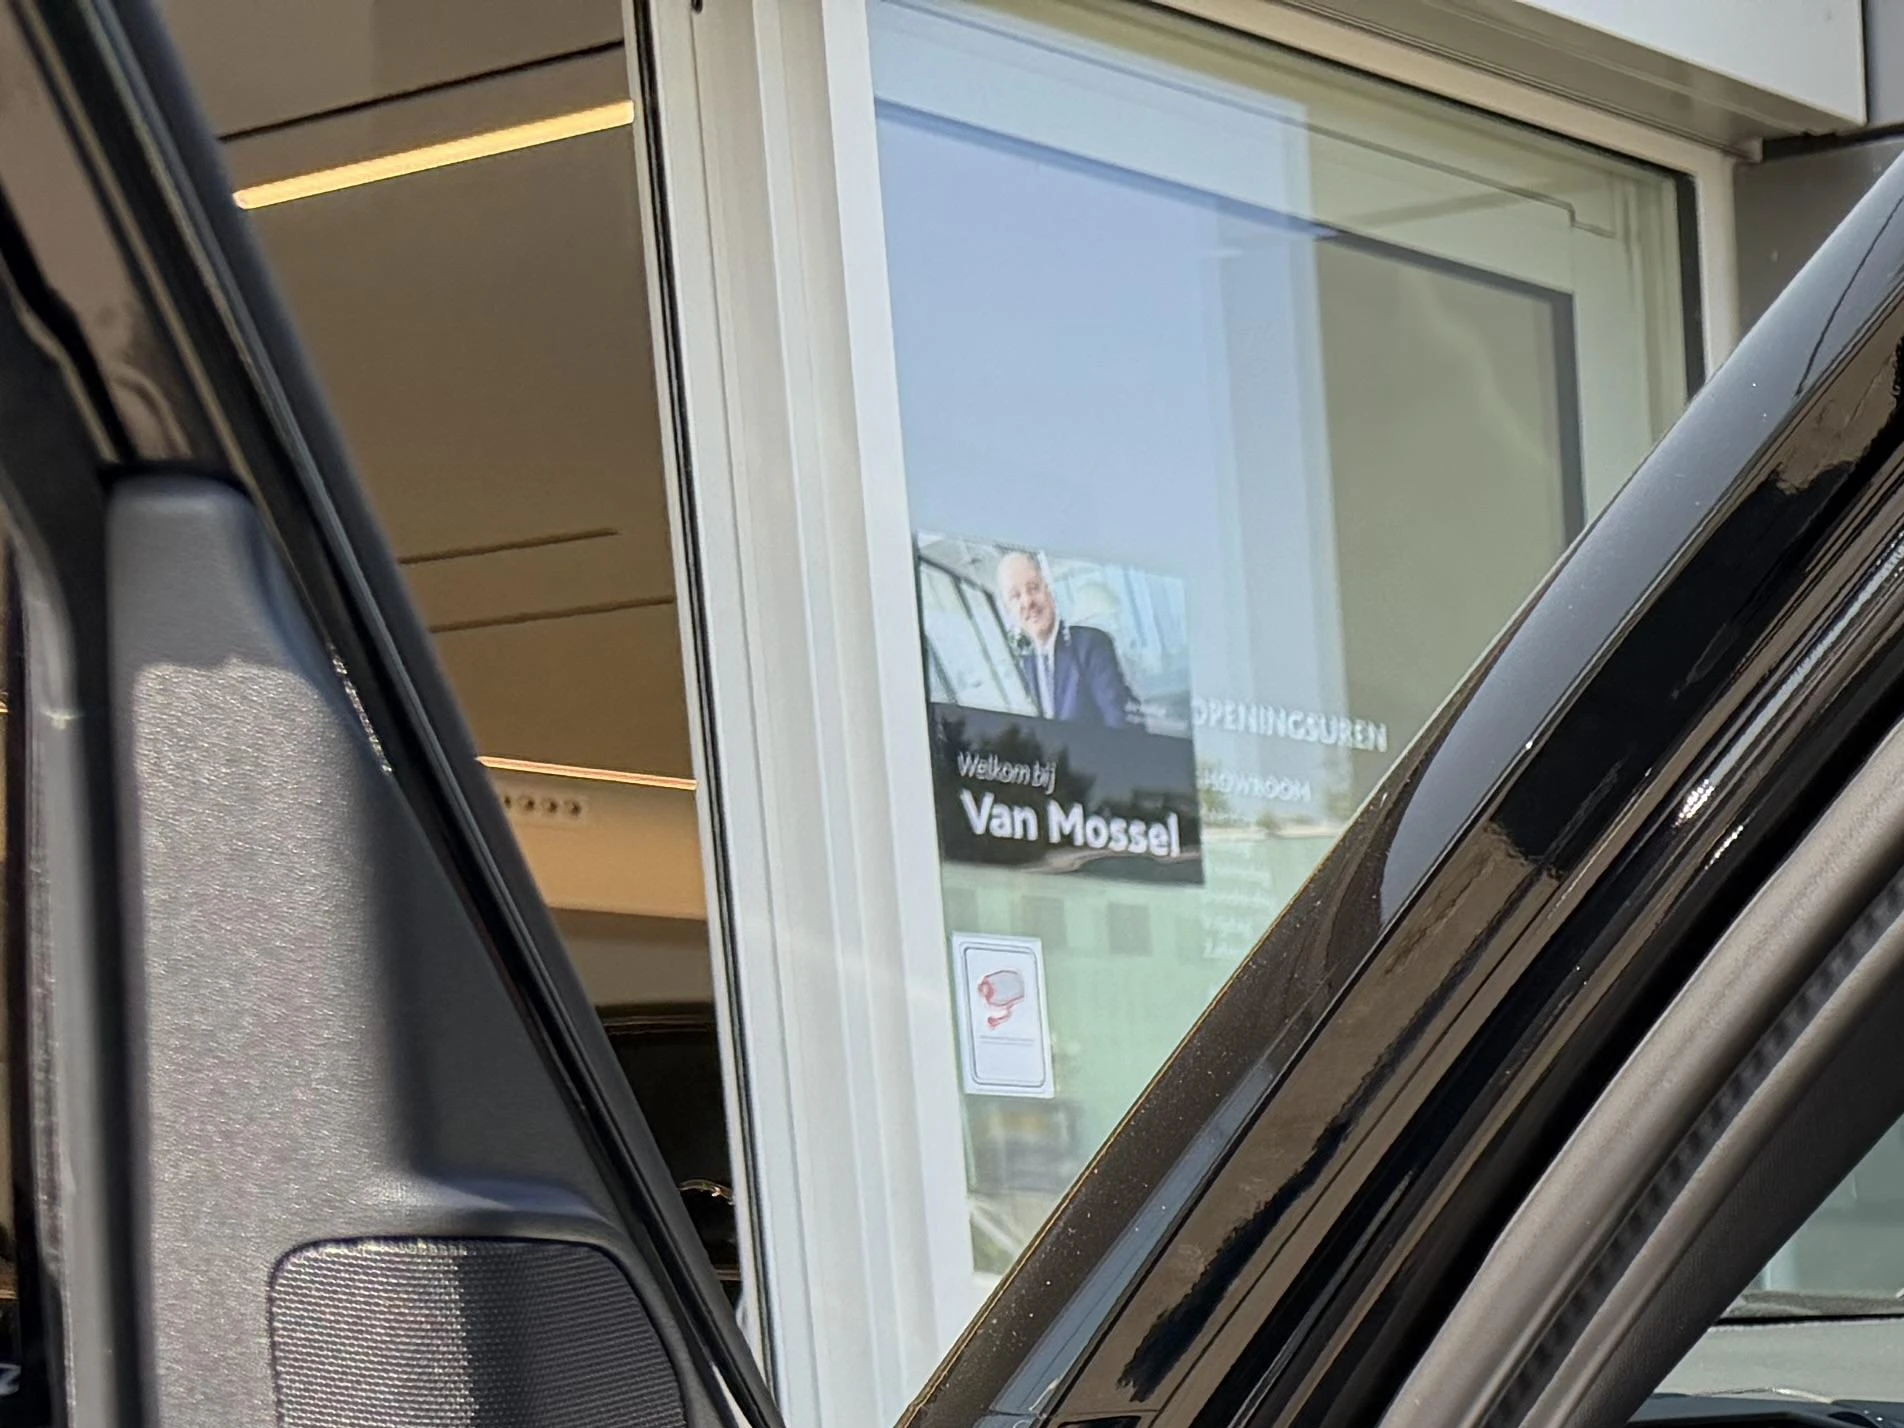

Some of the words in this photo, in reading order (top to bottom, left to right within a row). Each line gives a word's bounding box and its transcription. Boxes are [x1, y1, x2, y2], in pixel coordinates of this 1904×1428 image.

[957, 751, 1031, 784] Welkom
[1032, 760, 1056, 795] bij
[959, 787, 1038, 842] Van
[1047, 799, 1181, 858] Mossel
